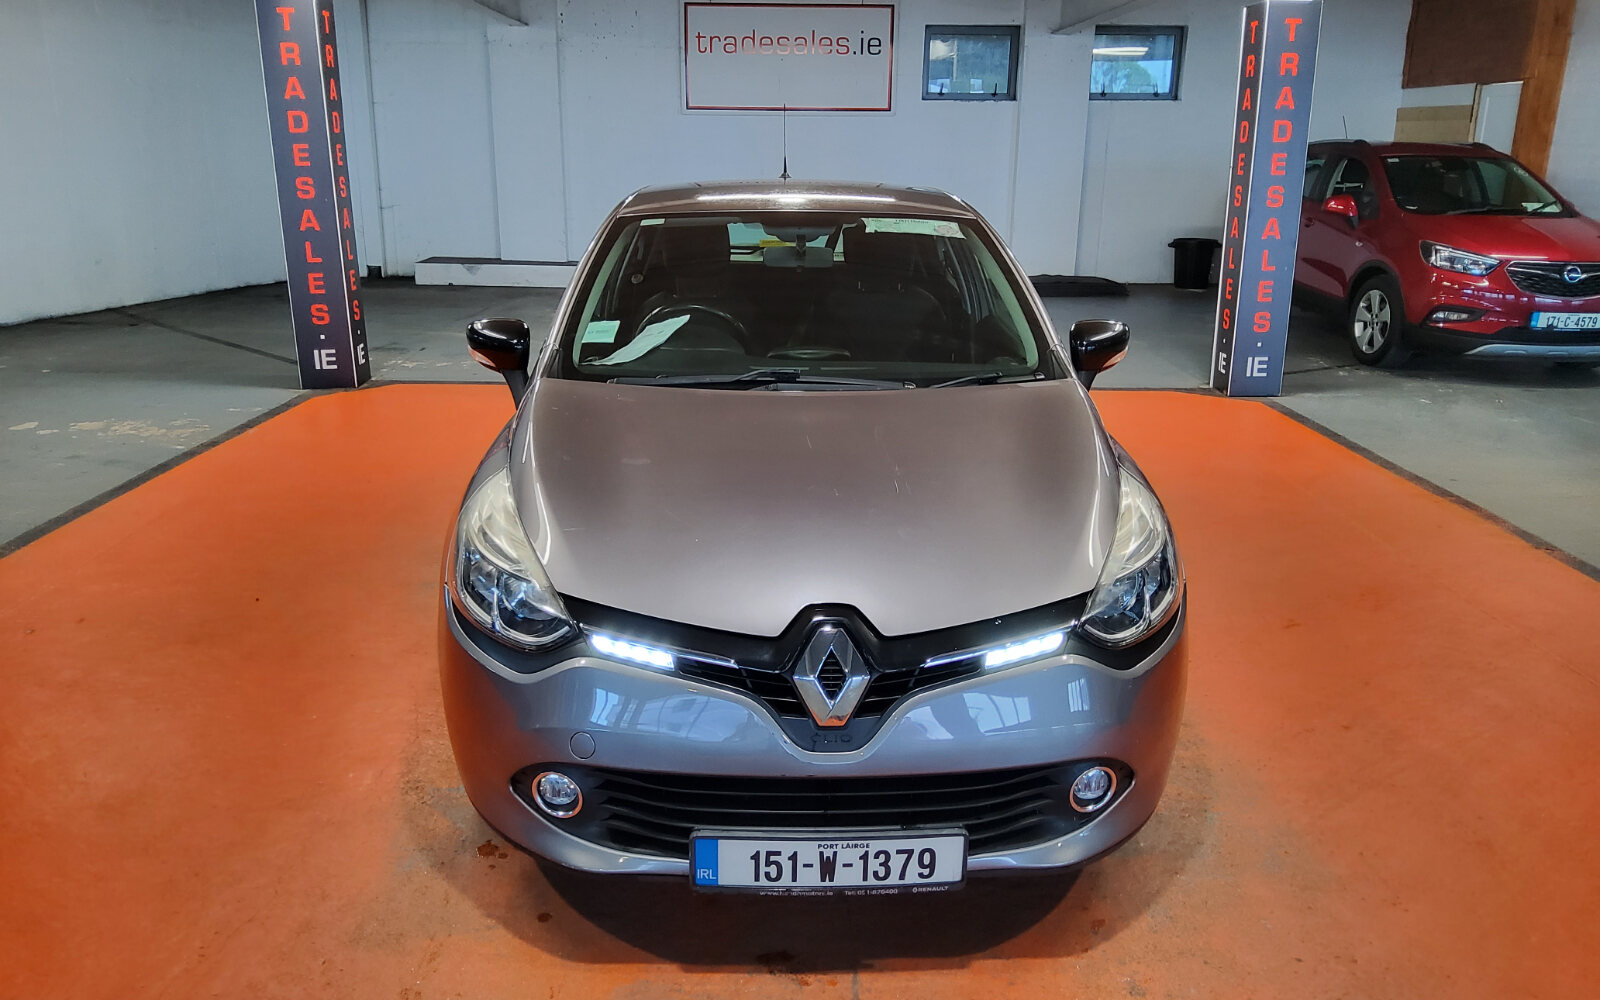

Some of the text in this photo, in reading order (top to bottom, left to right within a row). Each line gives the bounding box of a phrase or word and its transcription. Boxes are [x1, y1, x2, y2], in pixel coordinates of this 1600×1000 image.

[695, 29, 882, 56] tradesales.ie
[1546, 316, 1598, 328] 171-C-4579
[697, 868, 717, 880] IRL
[750, 847, 937, 883] 151-W-1379
